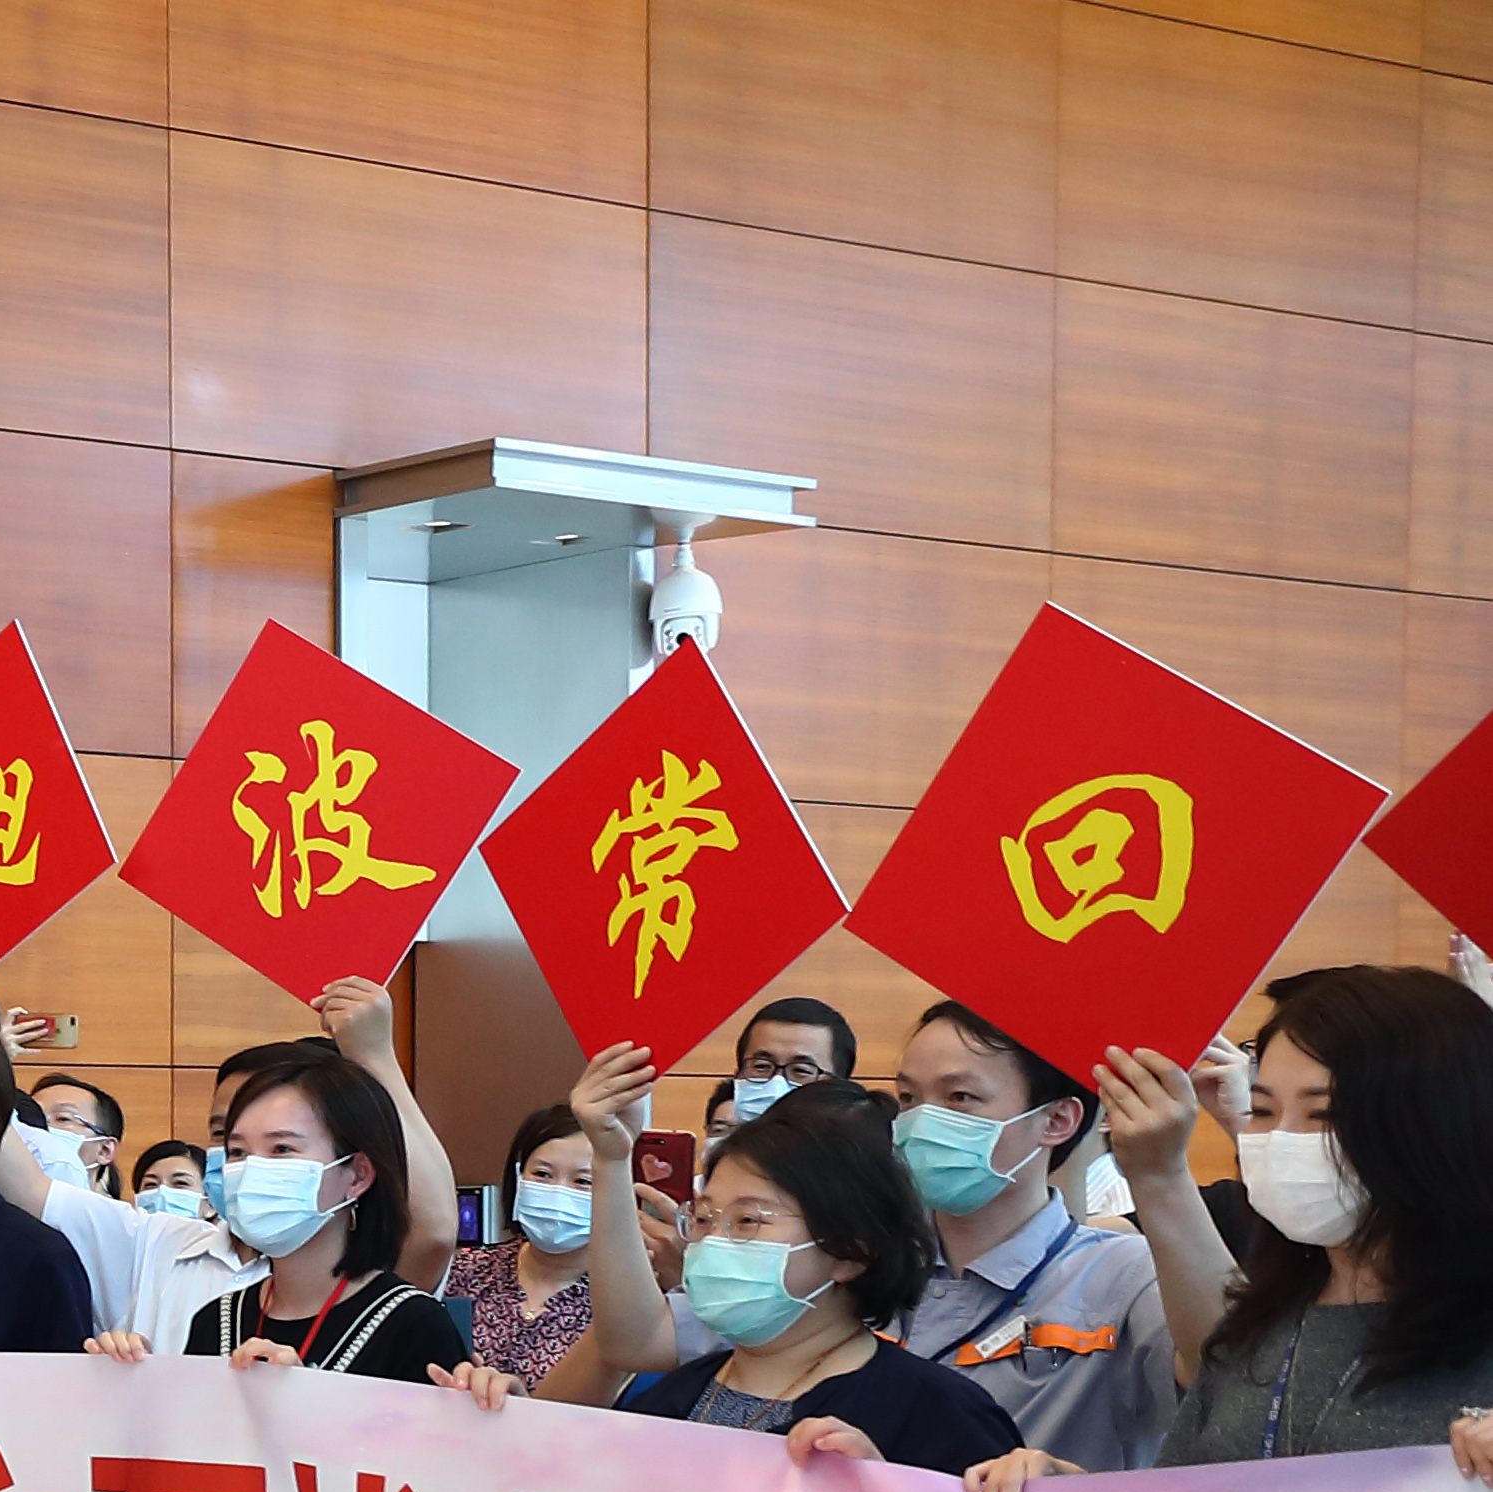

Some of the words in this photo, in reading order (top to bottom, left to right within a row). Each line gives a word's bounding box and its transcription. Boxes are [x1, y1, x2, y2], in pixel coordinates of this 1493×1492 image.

[232, 720, 437, 917] 波
[591, 750, 739, 998] 常
[1000, 773, 1195, 943] 回
